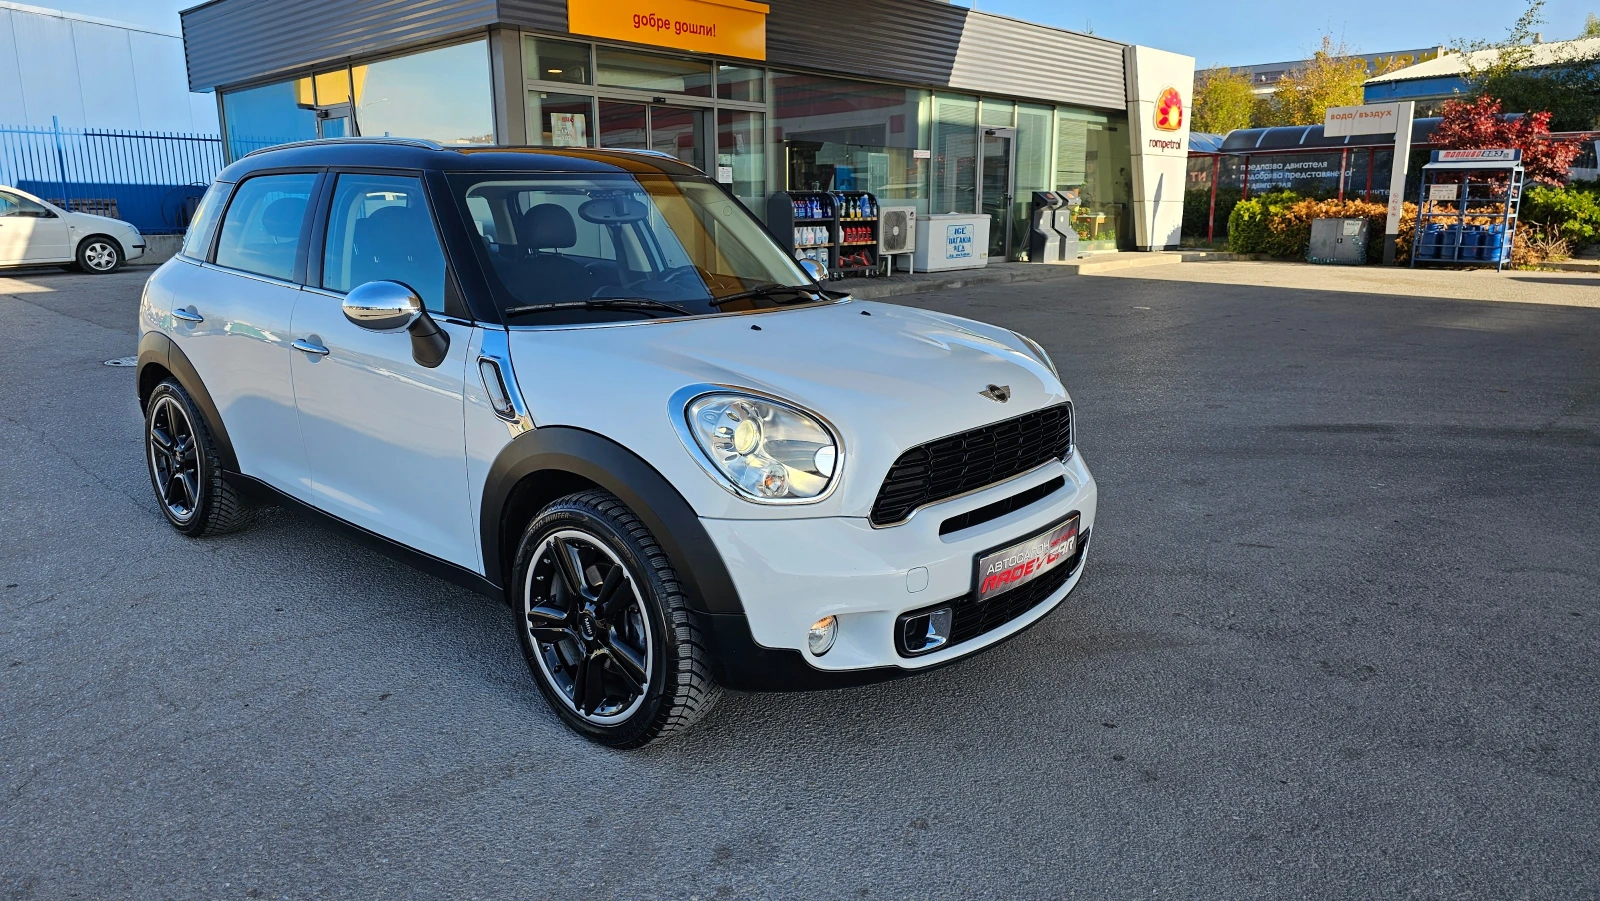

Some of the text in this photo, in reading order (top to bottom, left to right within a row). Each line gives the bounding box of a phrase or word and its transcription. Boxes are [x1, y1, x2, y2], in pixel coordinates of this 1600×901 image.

[633, 13, 716, 37] добре дошли!
[1149, 138, 1182, 152] rompetrol
[1285, 161, 1328, 170] двигателя
[1284, 170, 1351, 181] представянео
[954, 227, 966, 235] ICE
[986, 540, 1050, 575] АВТОСАЛОН
